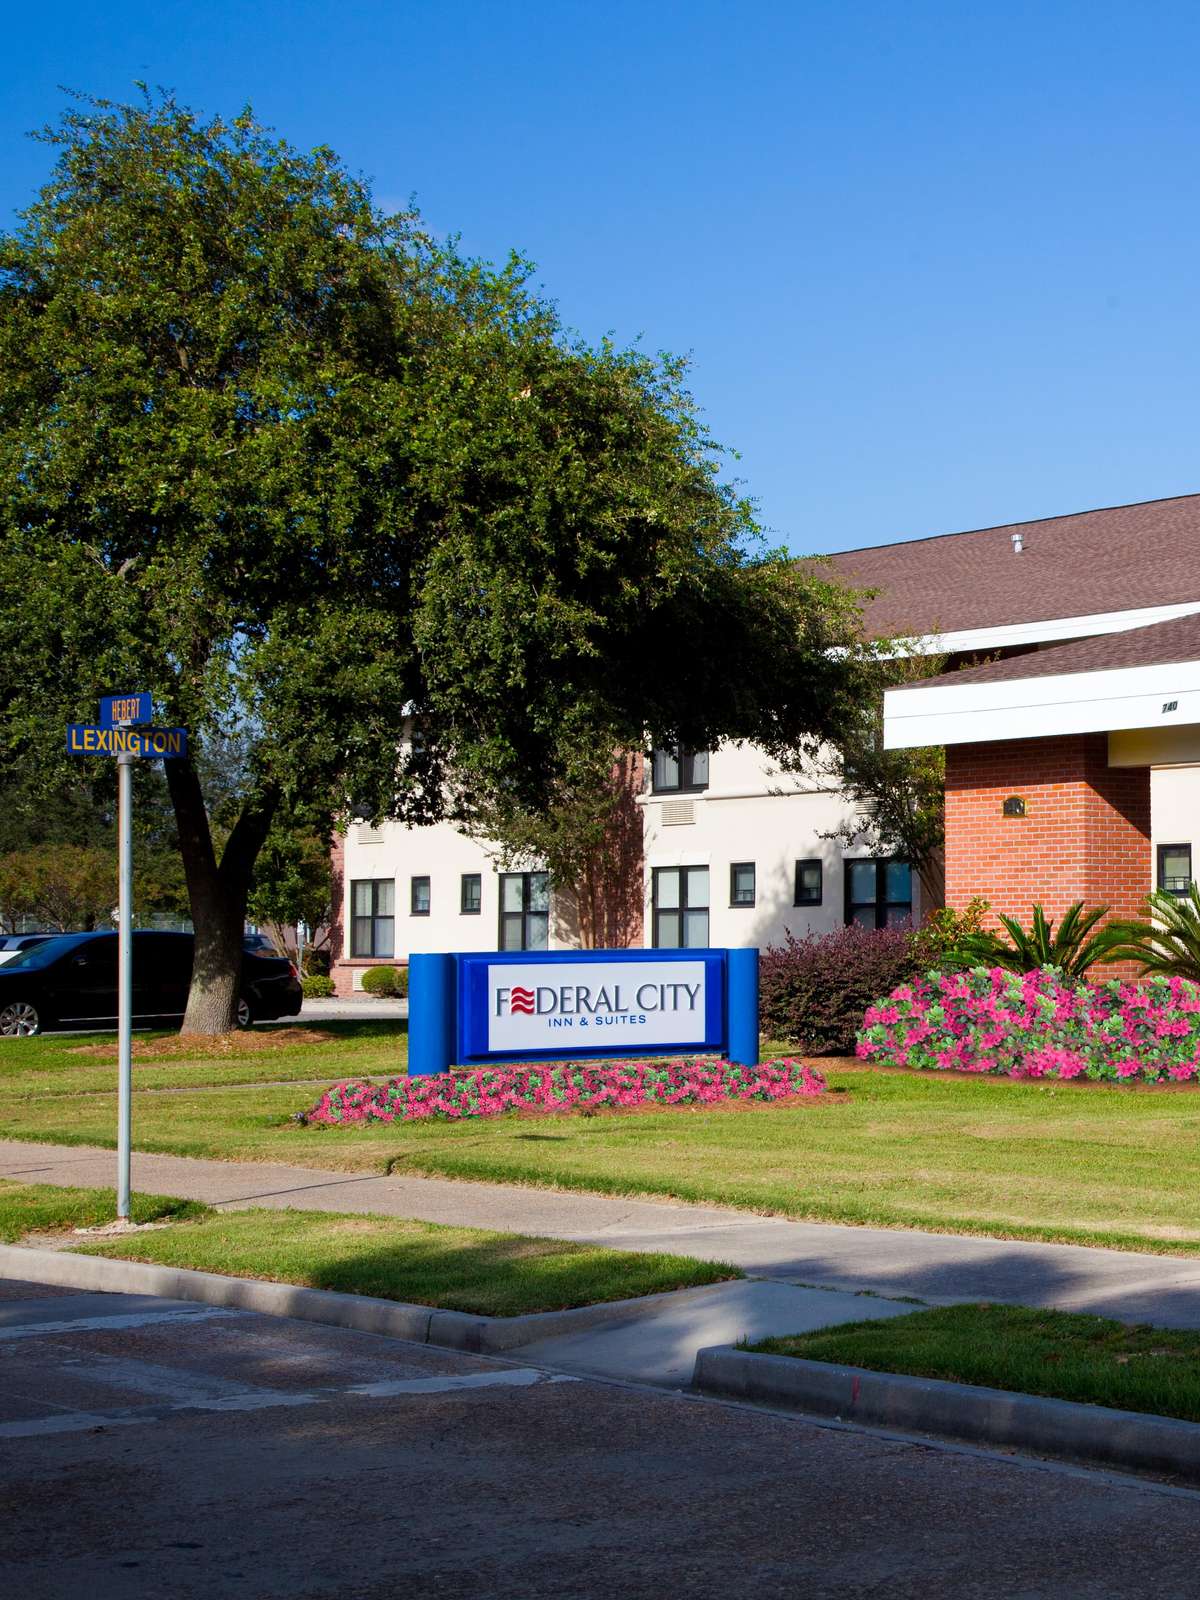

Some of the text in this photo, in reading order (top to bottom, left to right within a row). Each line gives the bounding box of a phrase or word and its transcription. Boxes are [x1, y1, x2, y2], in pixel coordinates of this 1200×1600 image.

[112, 698, 141, 721] HEBERT
[1161, 700, 1178, 714] 740
[71, 728, 181, 753] LEXINGTON
[636, 983, 701, 1012] CITY
[548, 1014, 647, 1028] INN & SUITES
